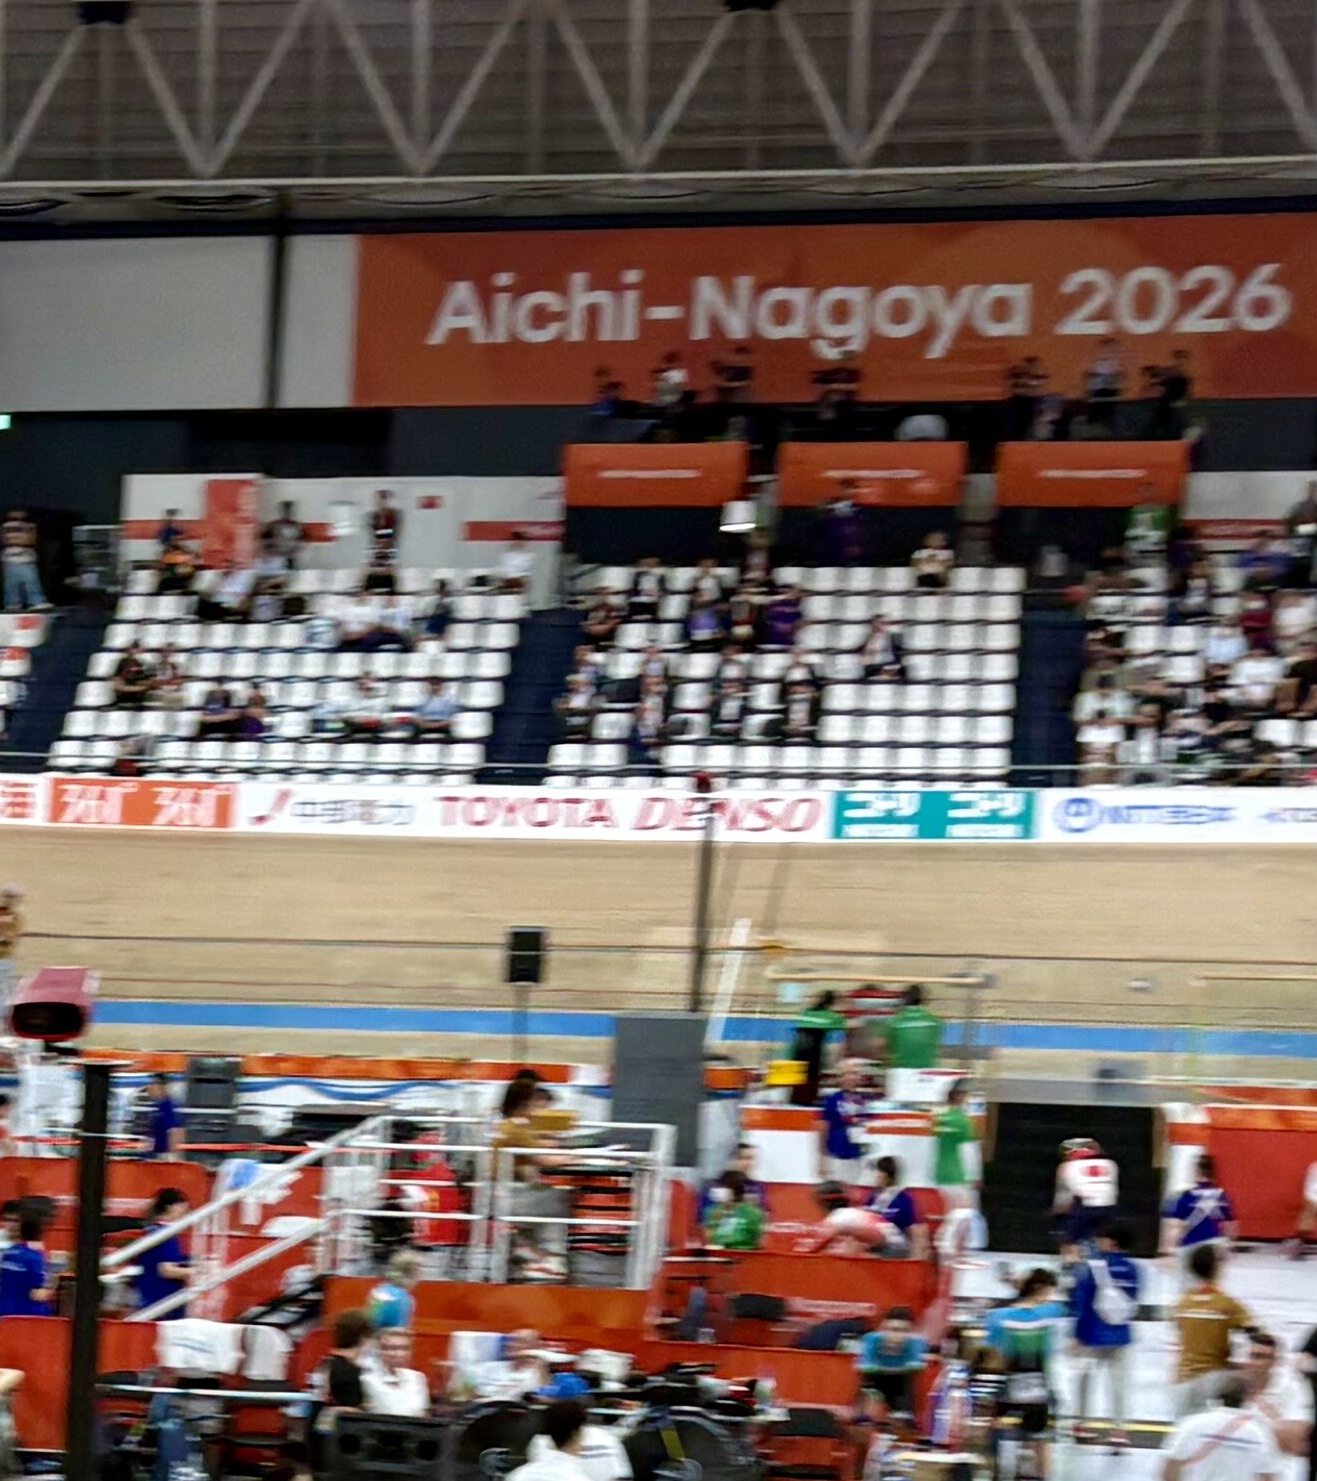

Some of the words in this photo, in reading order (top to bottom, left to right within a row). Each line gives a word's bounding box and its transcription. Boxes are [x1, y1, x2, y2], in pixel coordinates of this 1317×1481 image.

[426, 267, 1033, 359] Aichi-Nagoya
[1055, 263, 1292, 336] 2026
[435, 796, 618, 828] TOYOTA
[631, 797, 821, 832] DENSO
